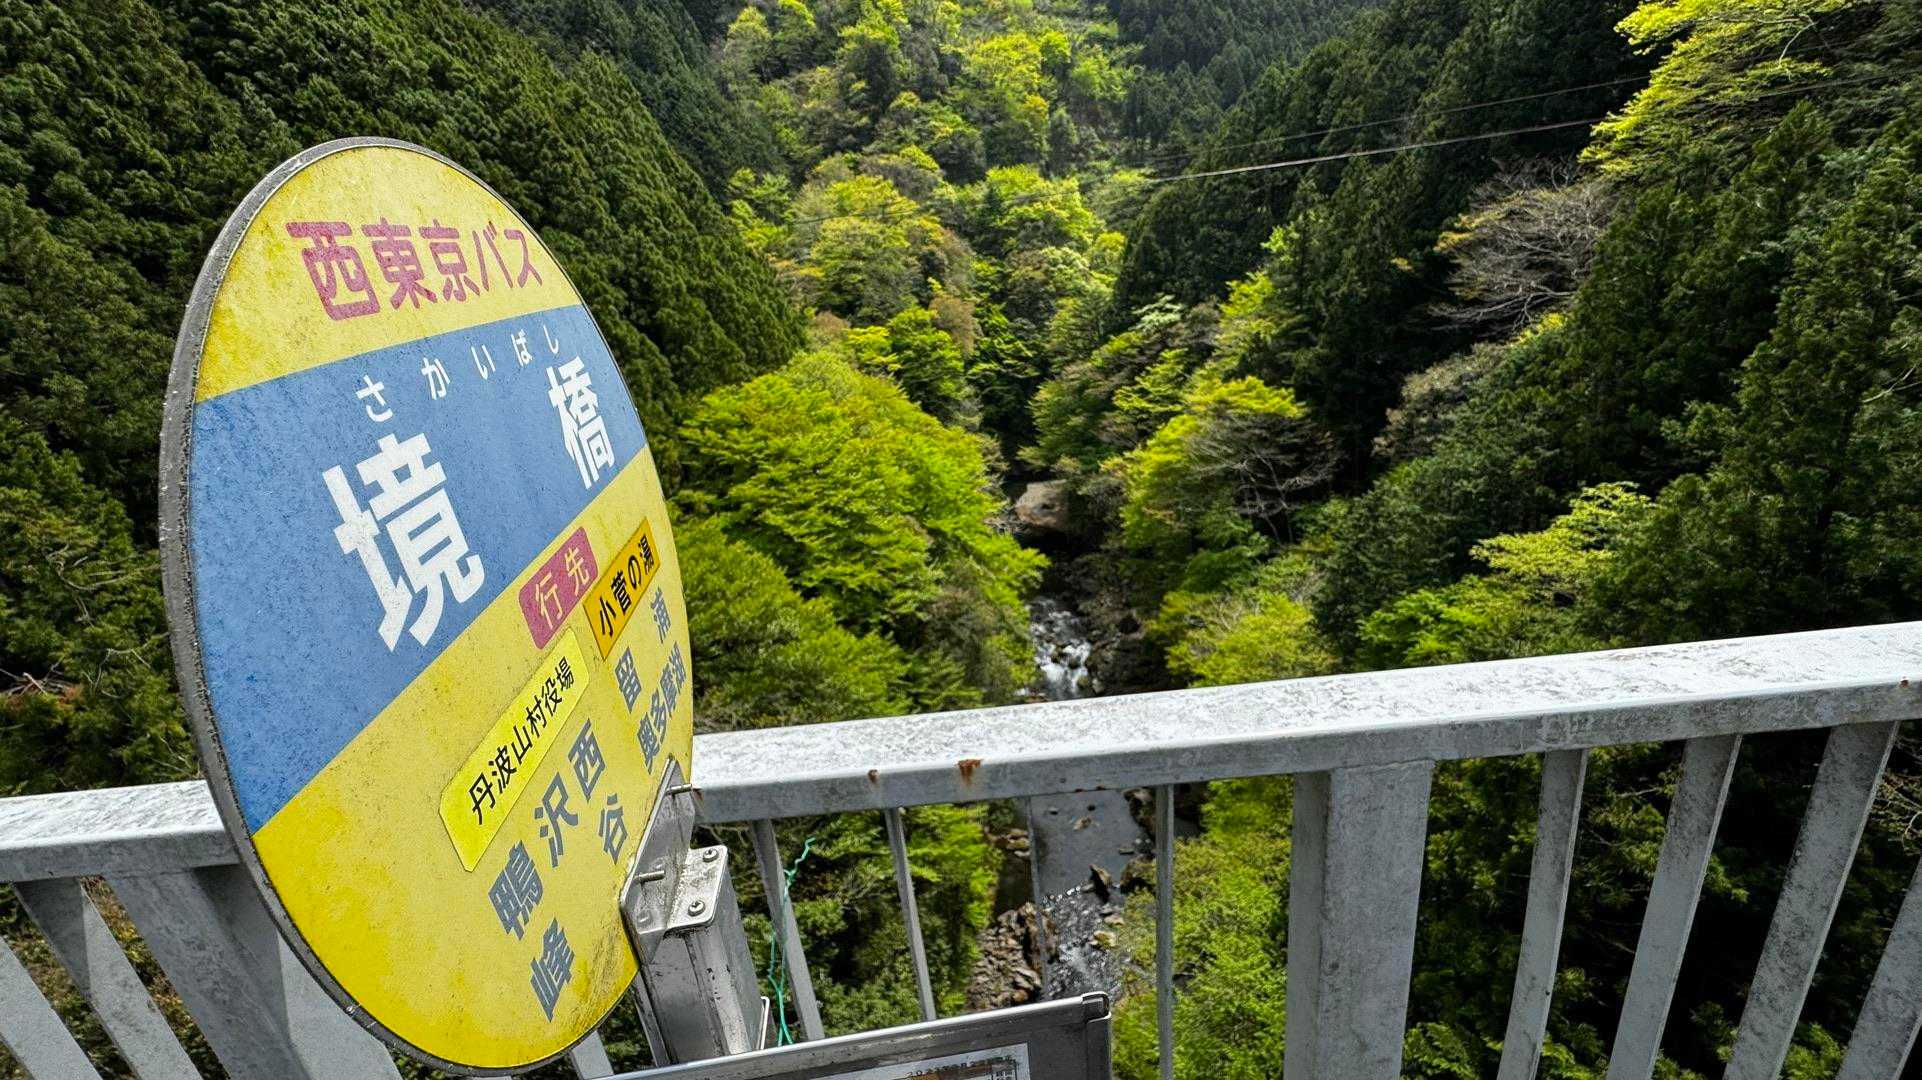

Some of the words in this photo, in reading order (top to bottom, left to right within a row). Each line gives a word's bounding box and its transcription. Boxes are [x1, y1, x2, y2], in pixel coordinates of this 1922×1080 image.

[285, 217, 542, 321] 西東京バス
[356, 325, 558, 422] さかいばし
[535, 547, 590, 629] 行先
[599, 534, 654, 638] 小菅の湯
[467, 656, 575, 825] 丹波山村役場
